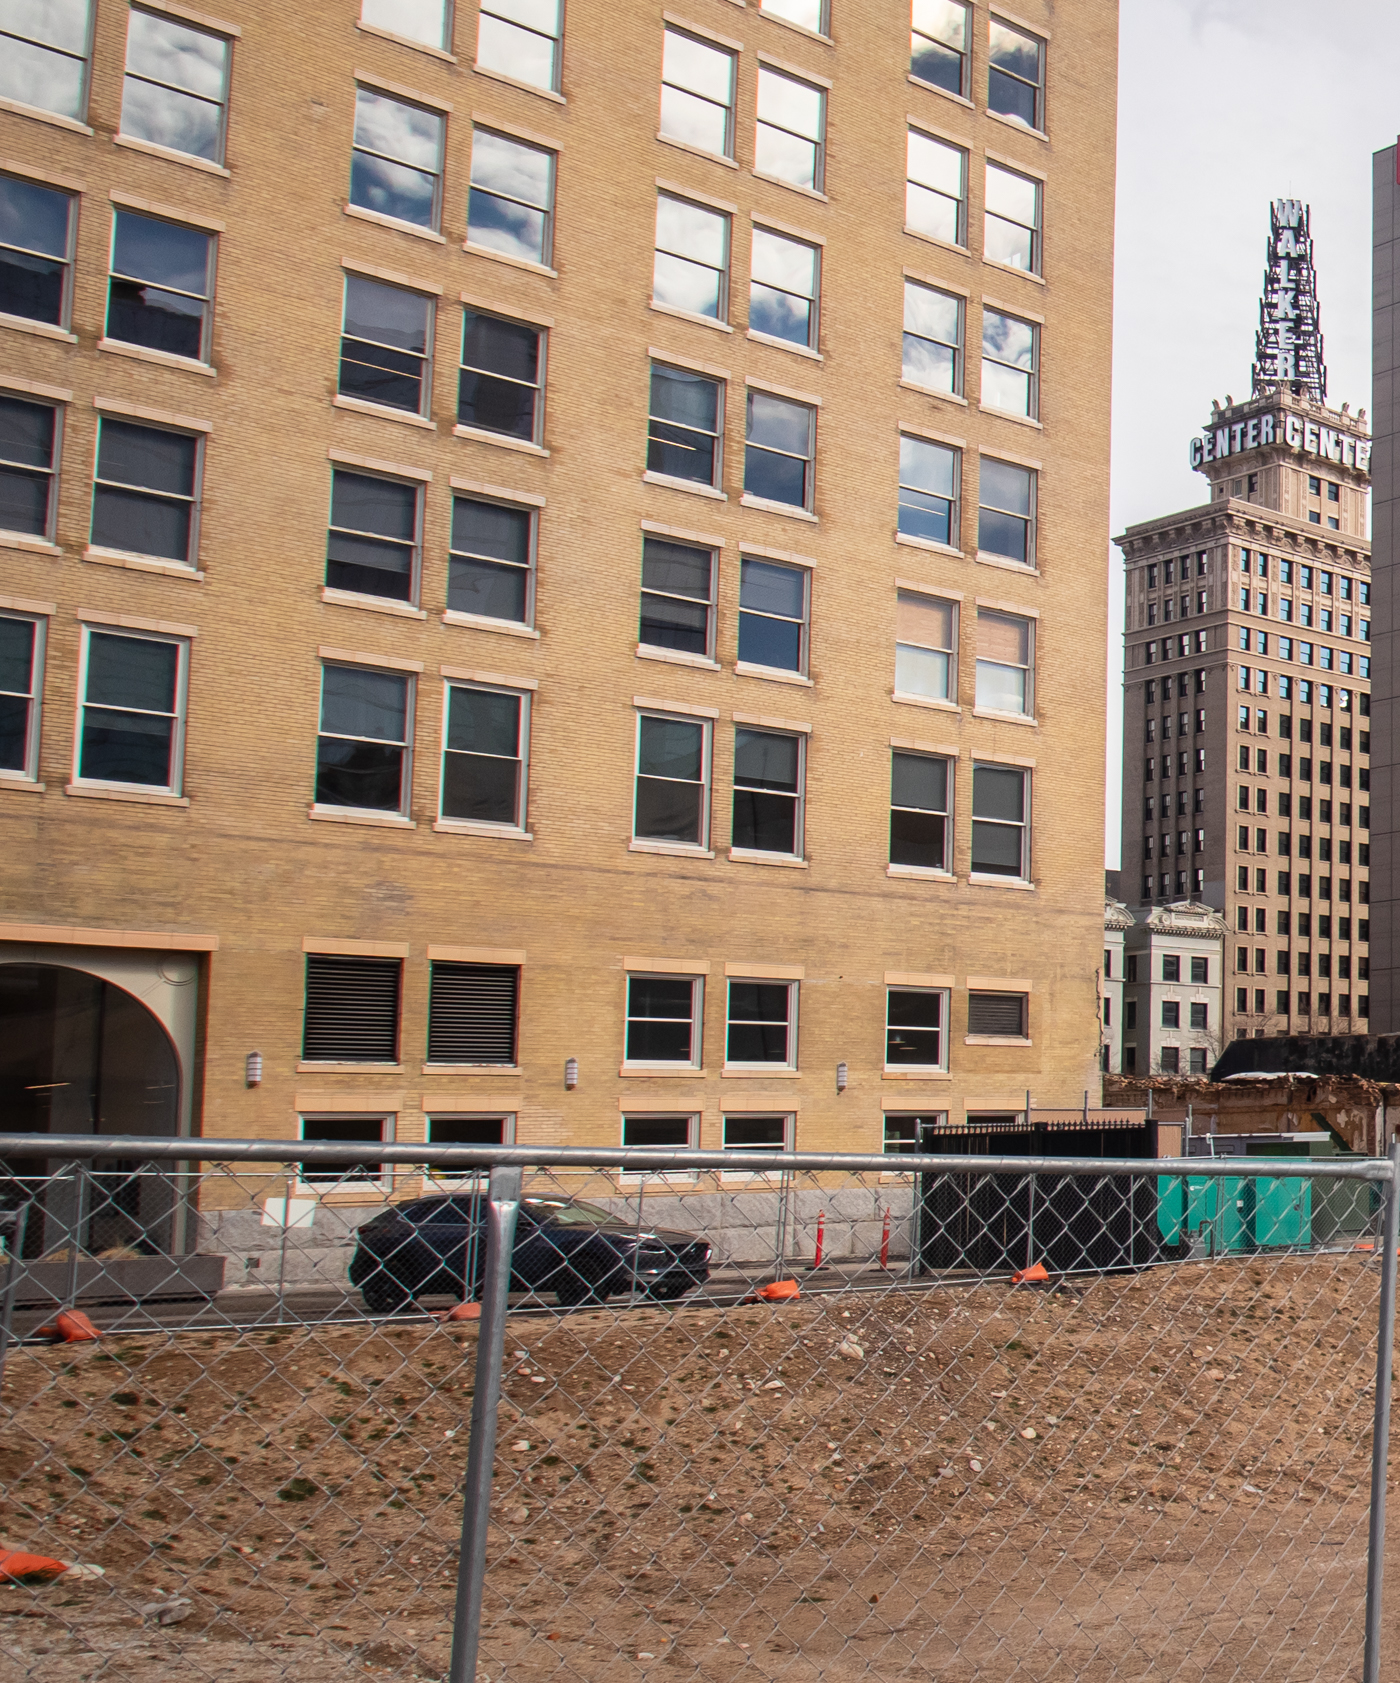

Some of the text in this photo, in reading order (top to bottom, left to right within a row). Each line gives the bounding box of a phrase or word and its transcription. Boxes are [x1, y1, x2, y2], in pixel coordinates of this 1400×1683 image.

[1277, 198, 1301, 381] WALKER
[1189, 414, 1274, 468] CENTER
[1285, 415, 1371, 471] CENTE
